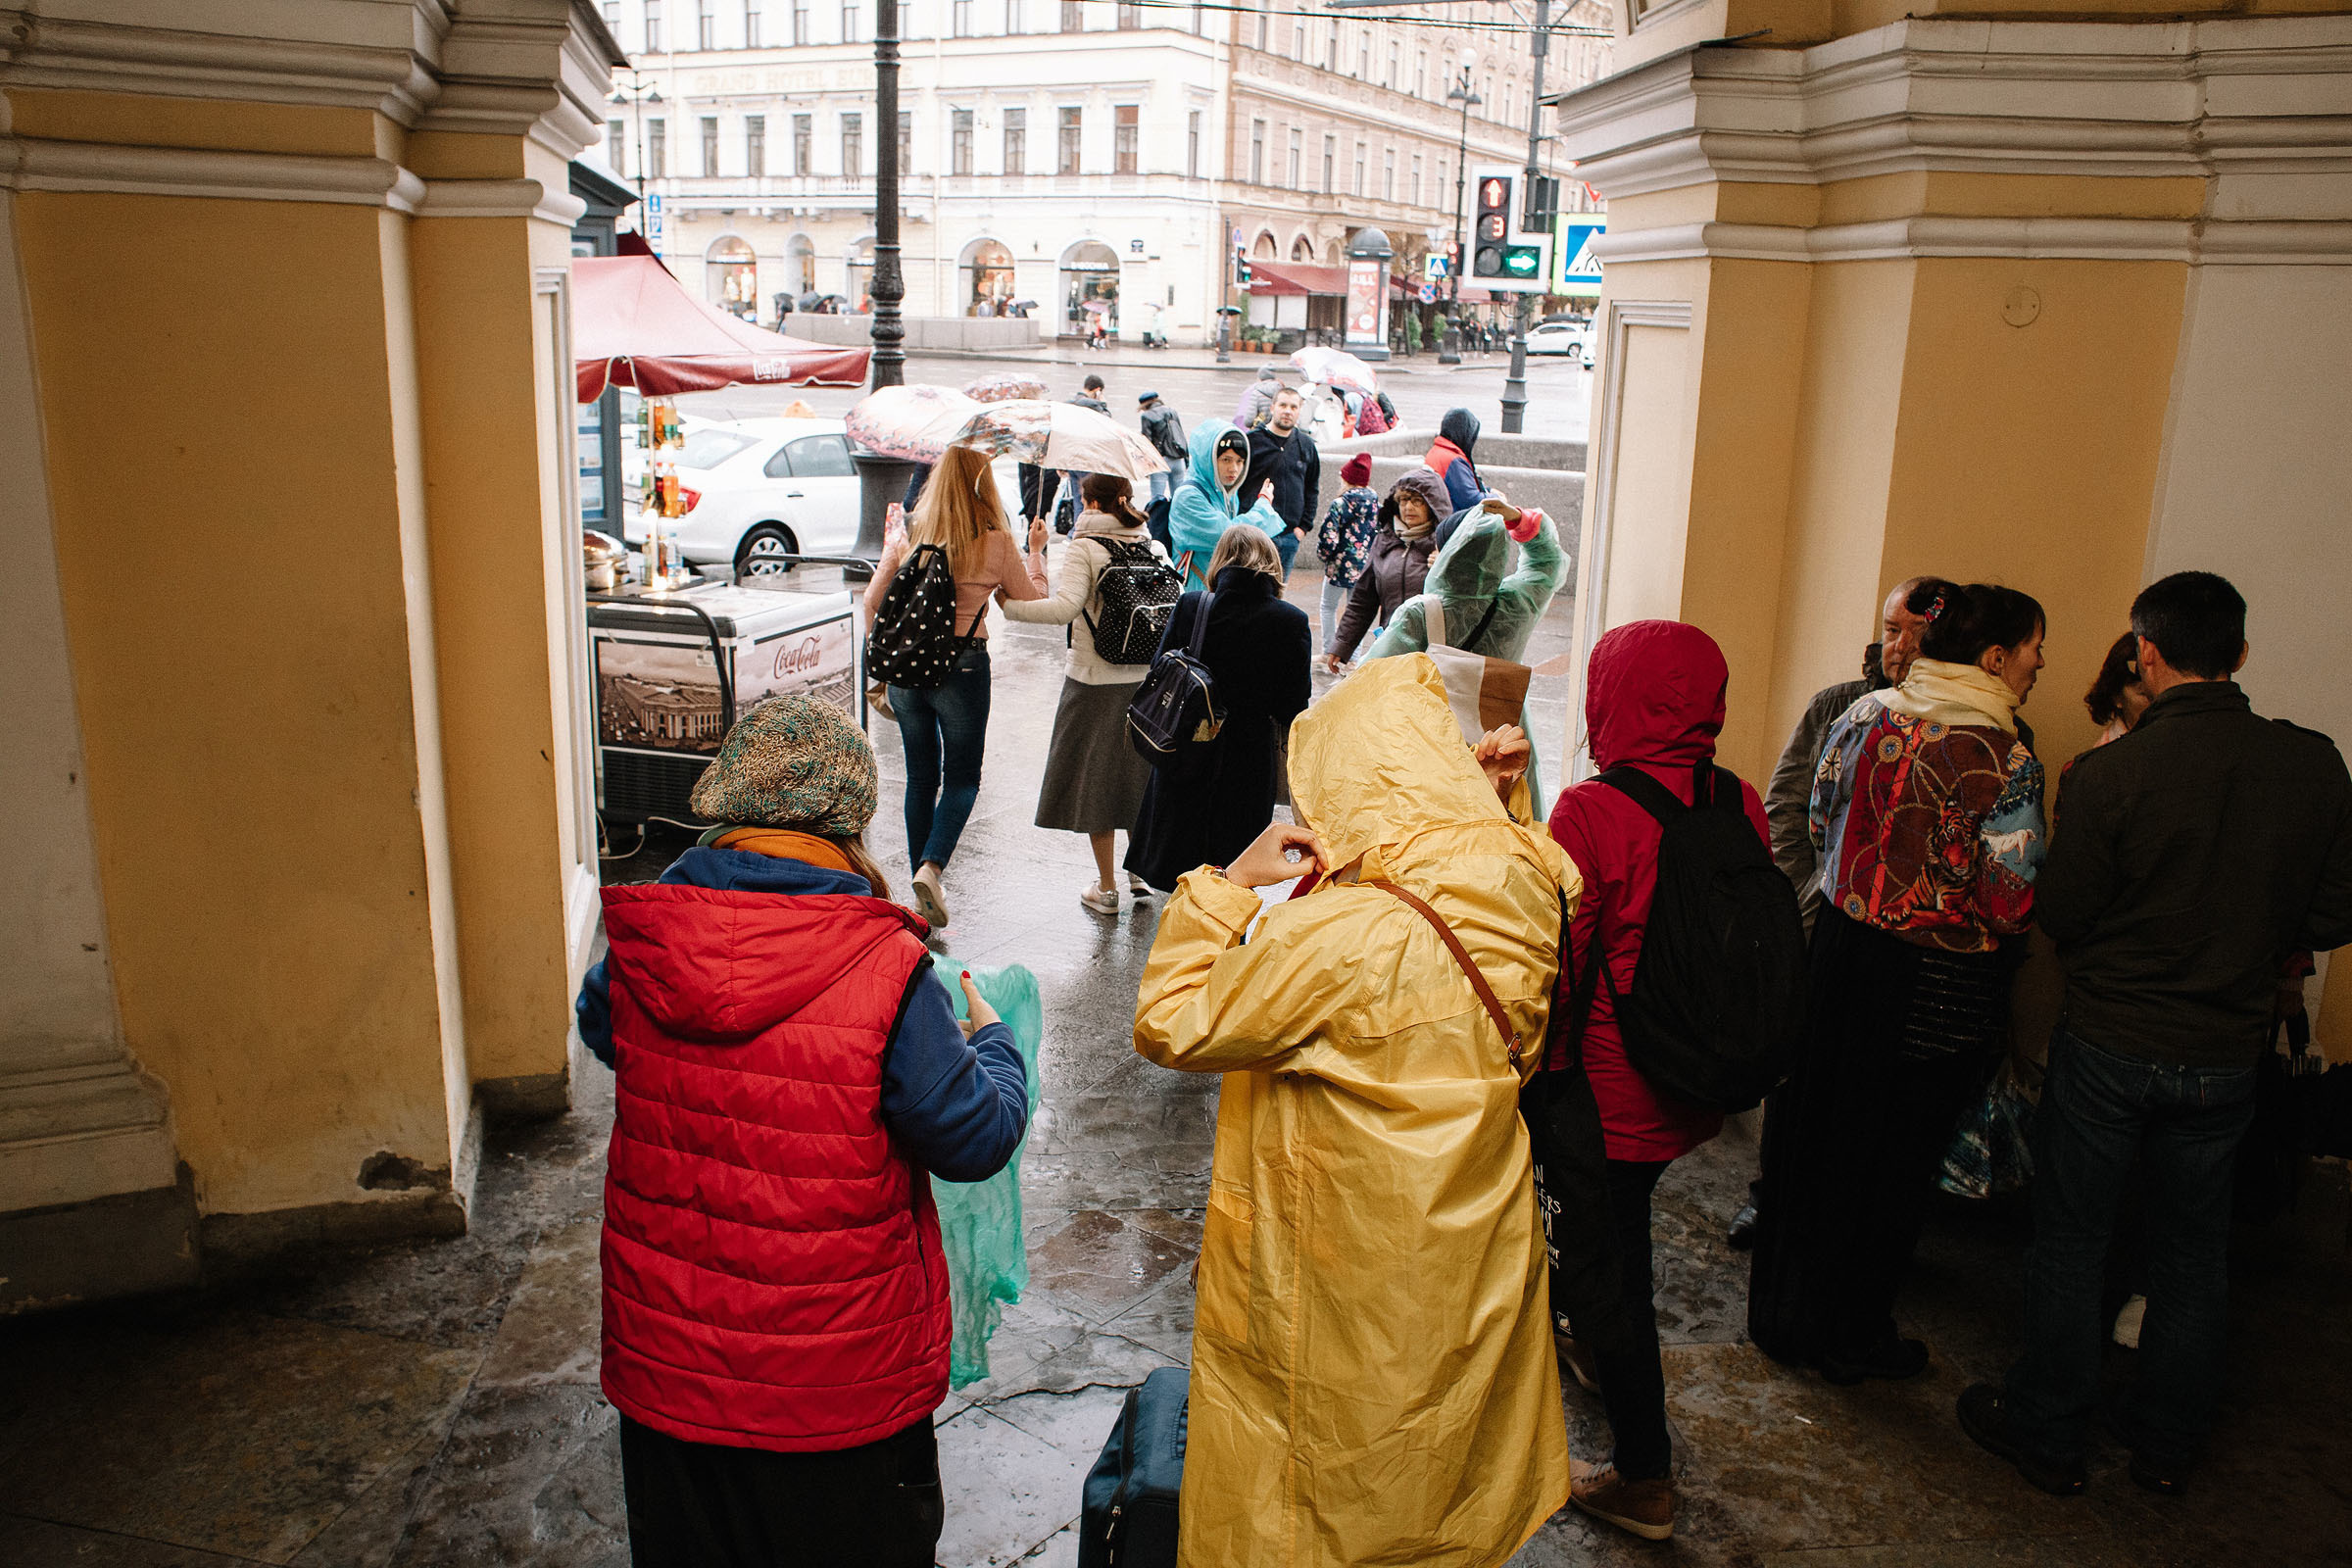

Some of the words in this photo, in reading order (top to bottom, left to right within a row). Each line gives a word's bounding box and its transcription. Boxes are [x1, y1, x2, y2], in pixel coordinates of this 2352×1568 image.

[696, 72, 758, 93] GRAND
[765, 69, 825, 89] HOTEL
[838, 65, 914, 86] EURE
[1492, 215, 1505, 238] 3
